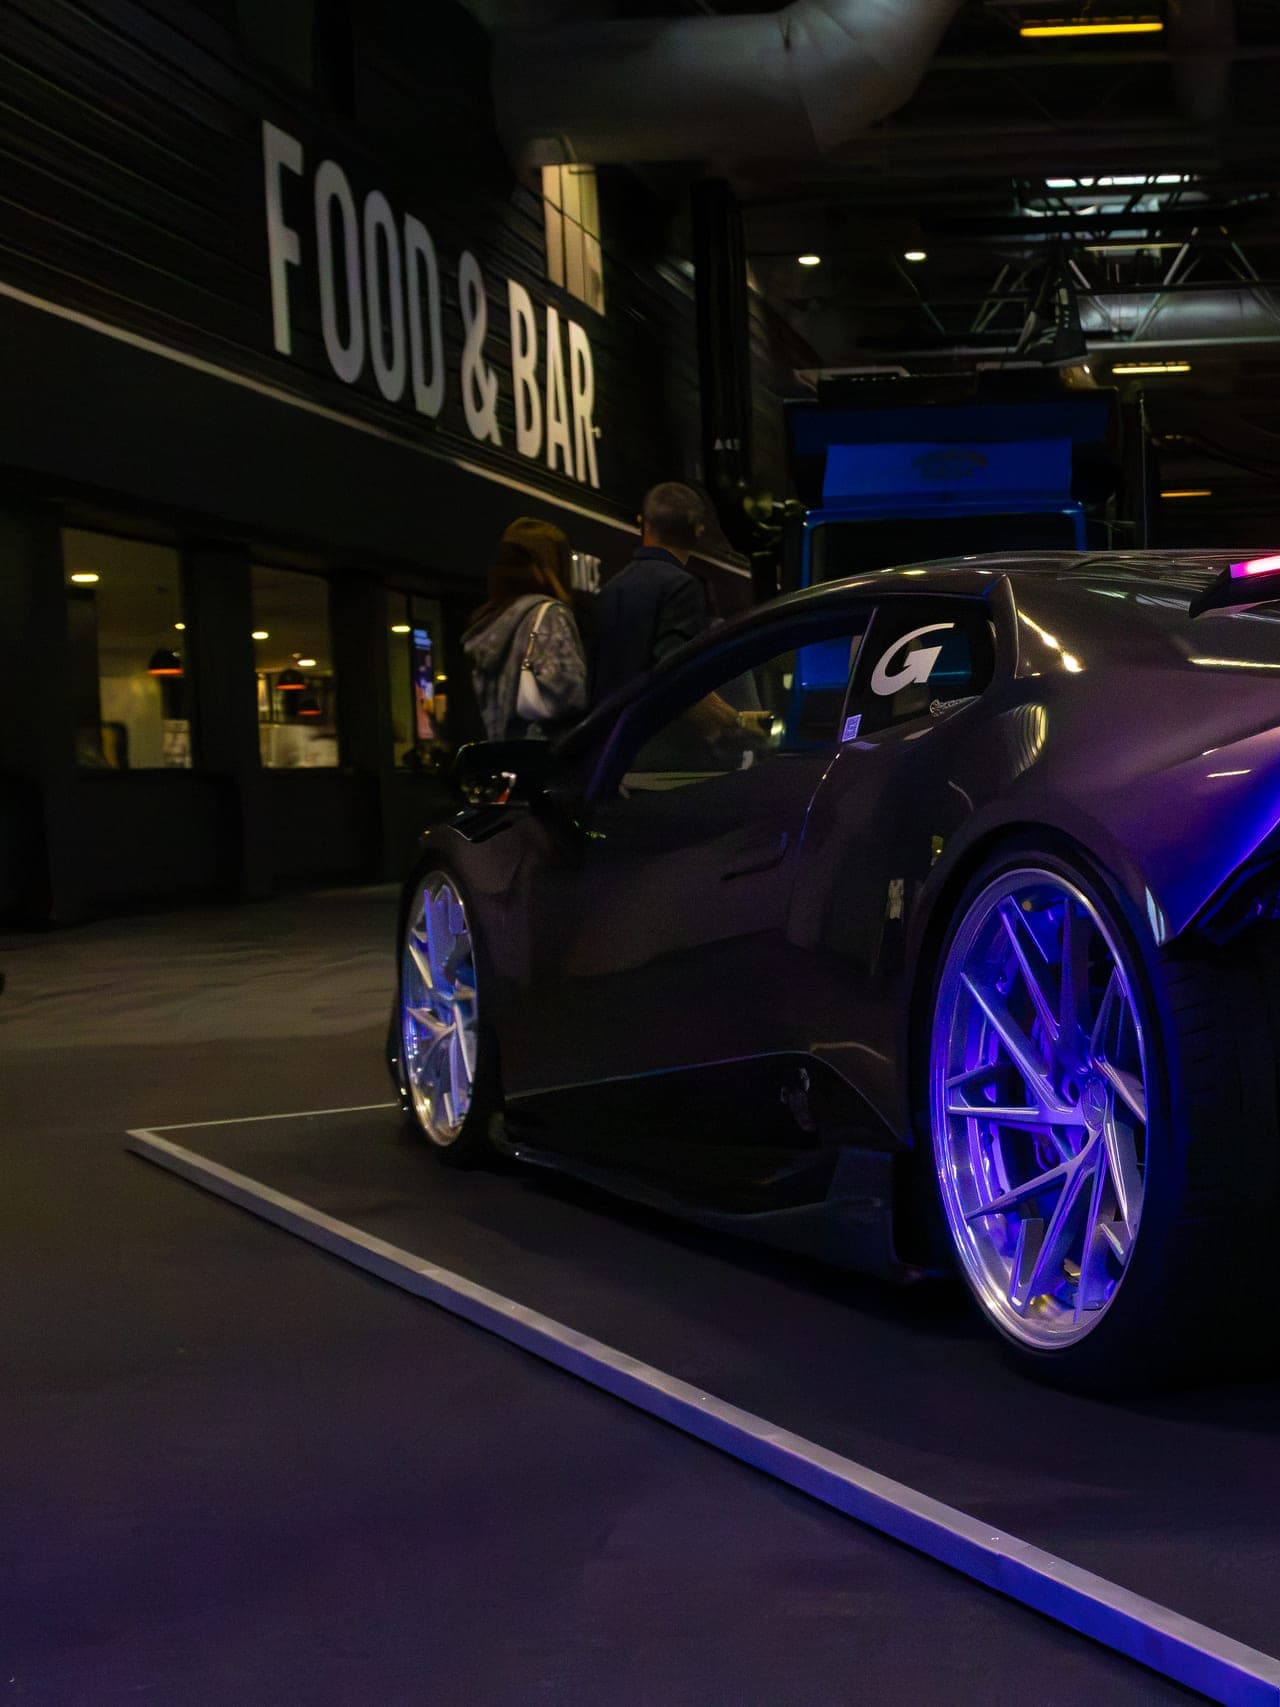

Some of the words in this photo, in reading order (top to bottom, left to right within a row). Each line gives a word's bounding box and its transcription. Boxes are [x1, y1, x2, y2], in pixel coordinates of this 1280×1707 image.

[262, 118, 446, 419] FOOD
[457, 249, 503, 447] &
[507, 277, 600, 489] BAR
[871, 622, 955, 696] G
